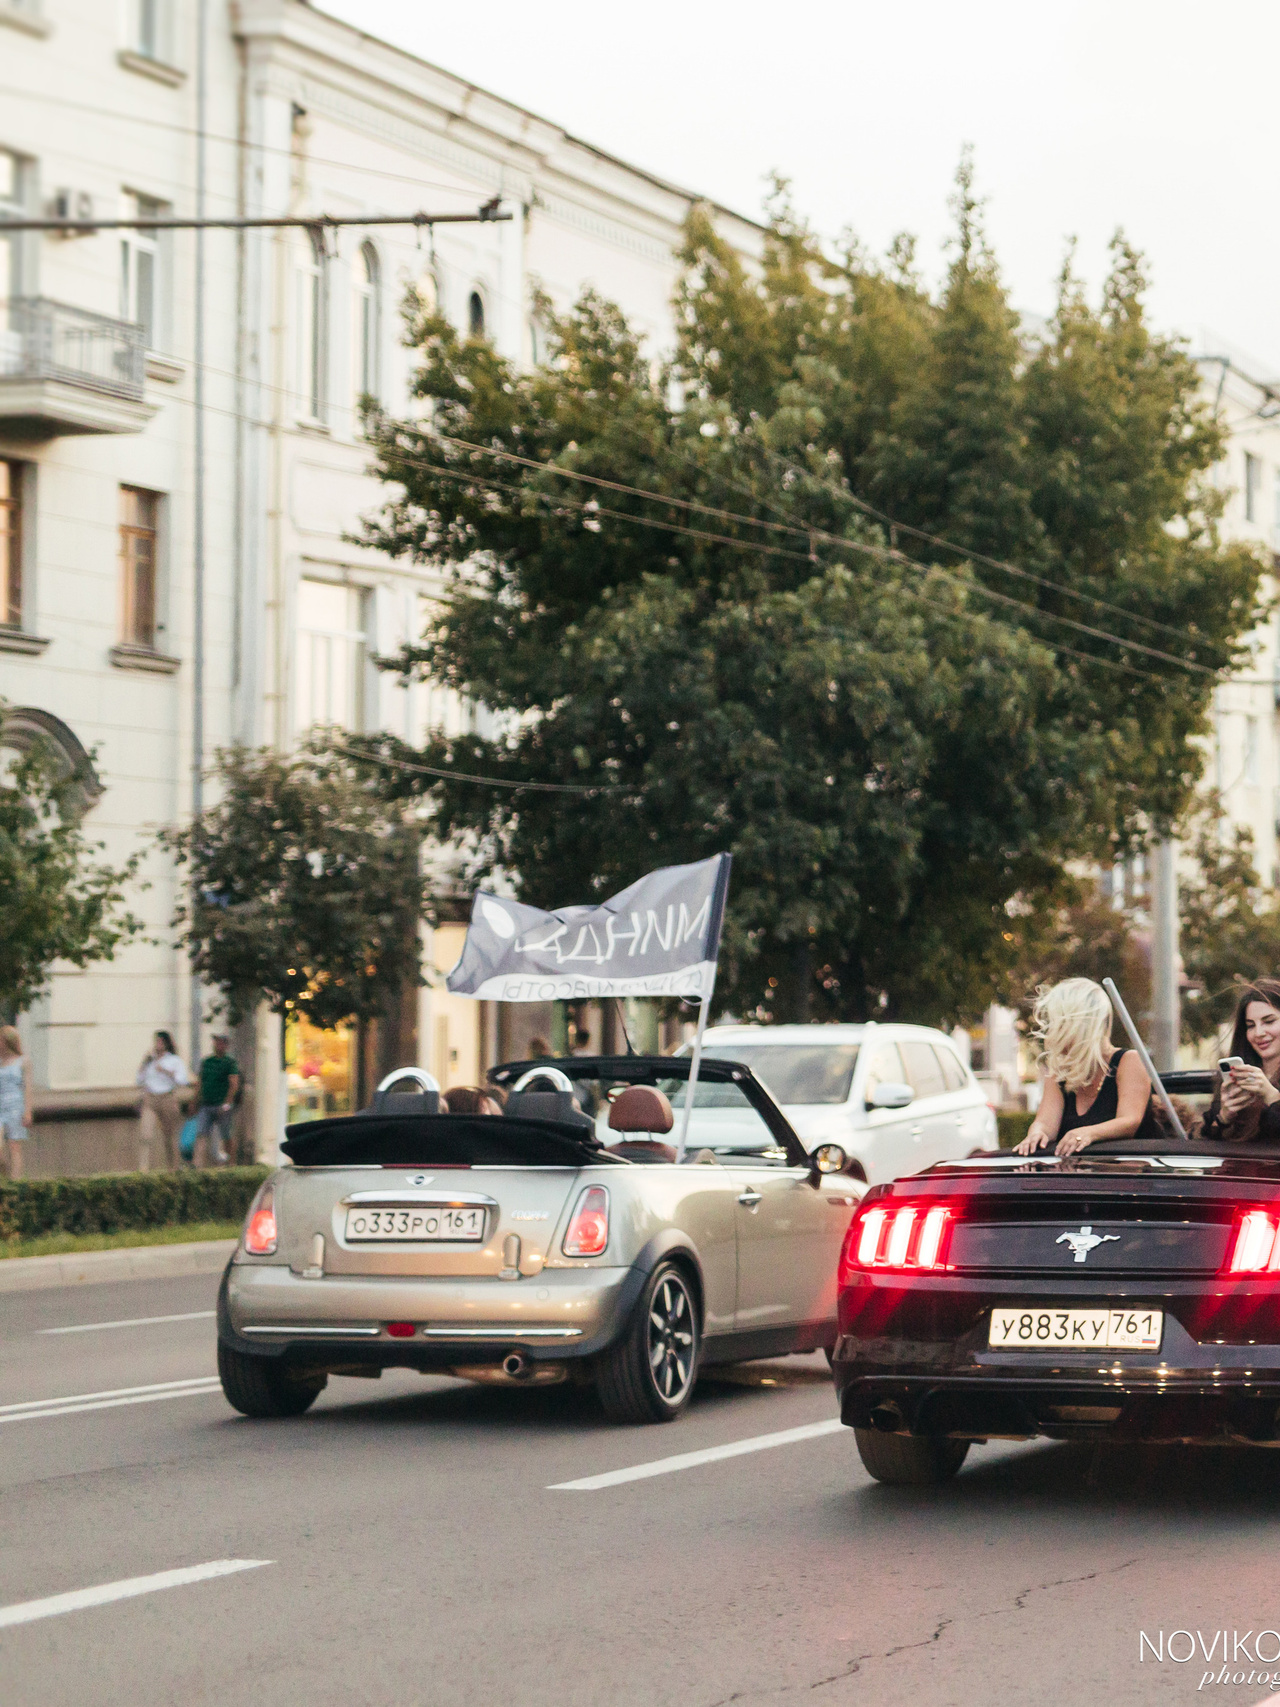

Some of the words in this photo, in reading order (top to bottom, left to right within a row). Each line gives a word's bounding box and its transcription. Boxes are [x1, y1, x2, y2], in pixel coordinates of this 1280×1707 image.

[444, 1211, 477, 1228] 161
[1002, 1313, 1105, 1341] У883КУ
[1113, 1313, 1153, 1335] 761
[1120, 1335, 1141, 1343] RUS
